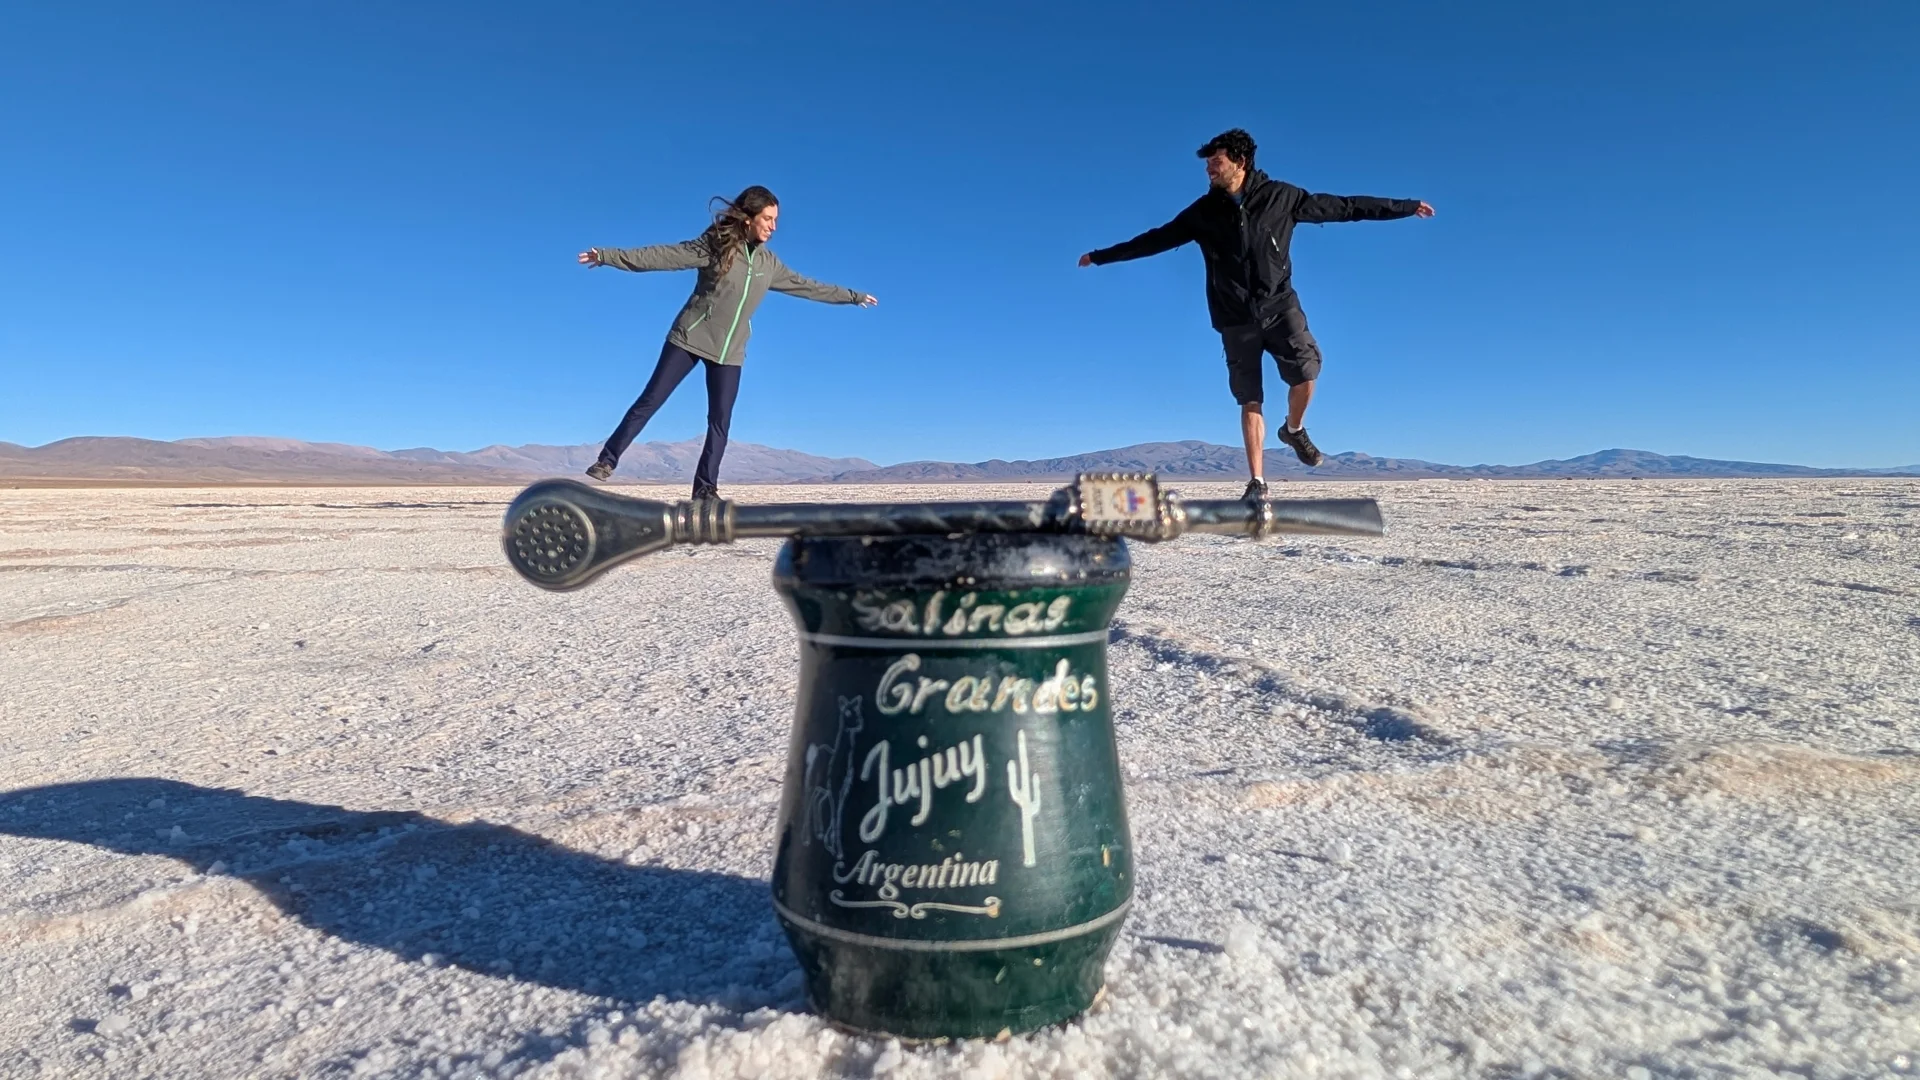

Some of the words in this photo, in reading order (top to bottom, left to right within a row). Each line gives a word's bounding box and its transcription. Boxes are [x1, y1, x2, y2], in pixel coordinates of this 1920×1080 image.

[876, 653, 1098, 715] Grandes
[859, 733, 986, 844] Jujuy
[833, 849, 999, 900] Argentina
